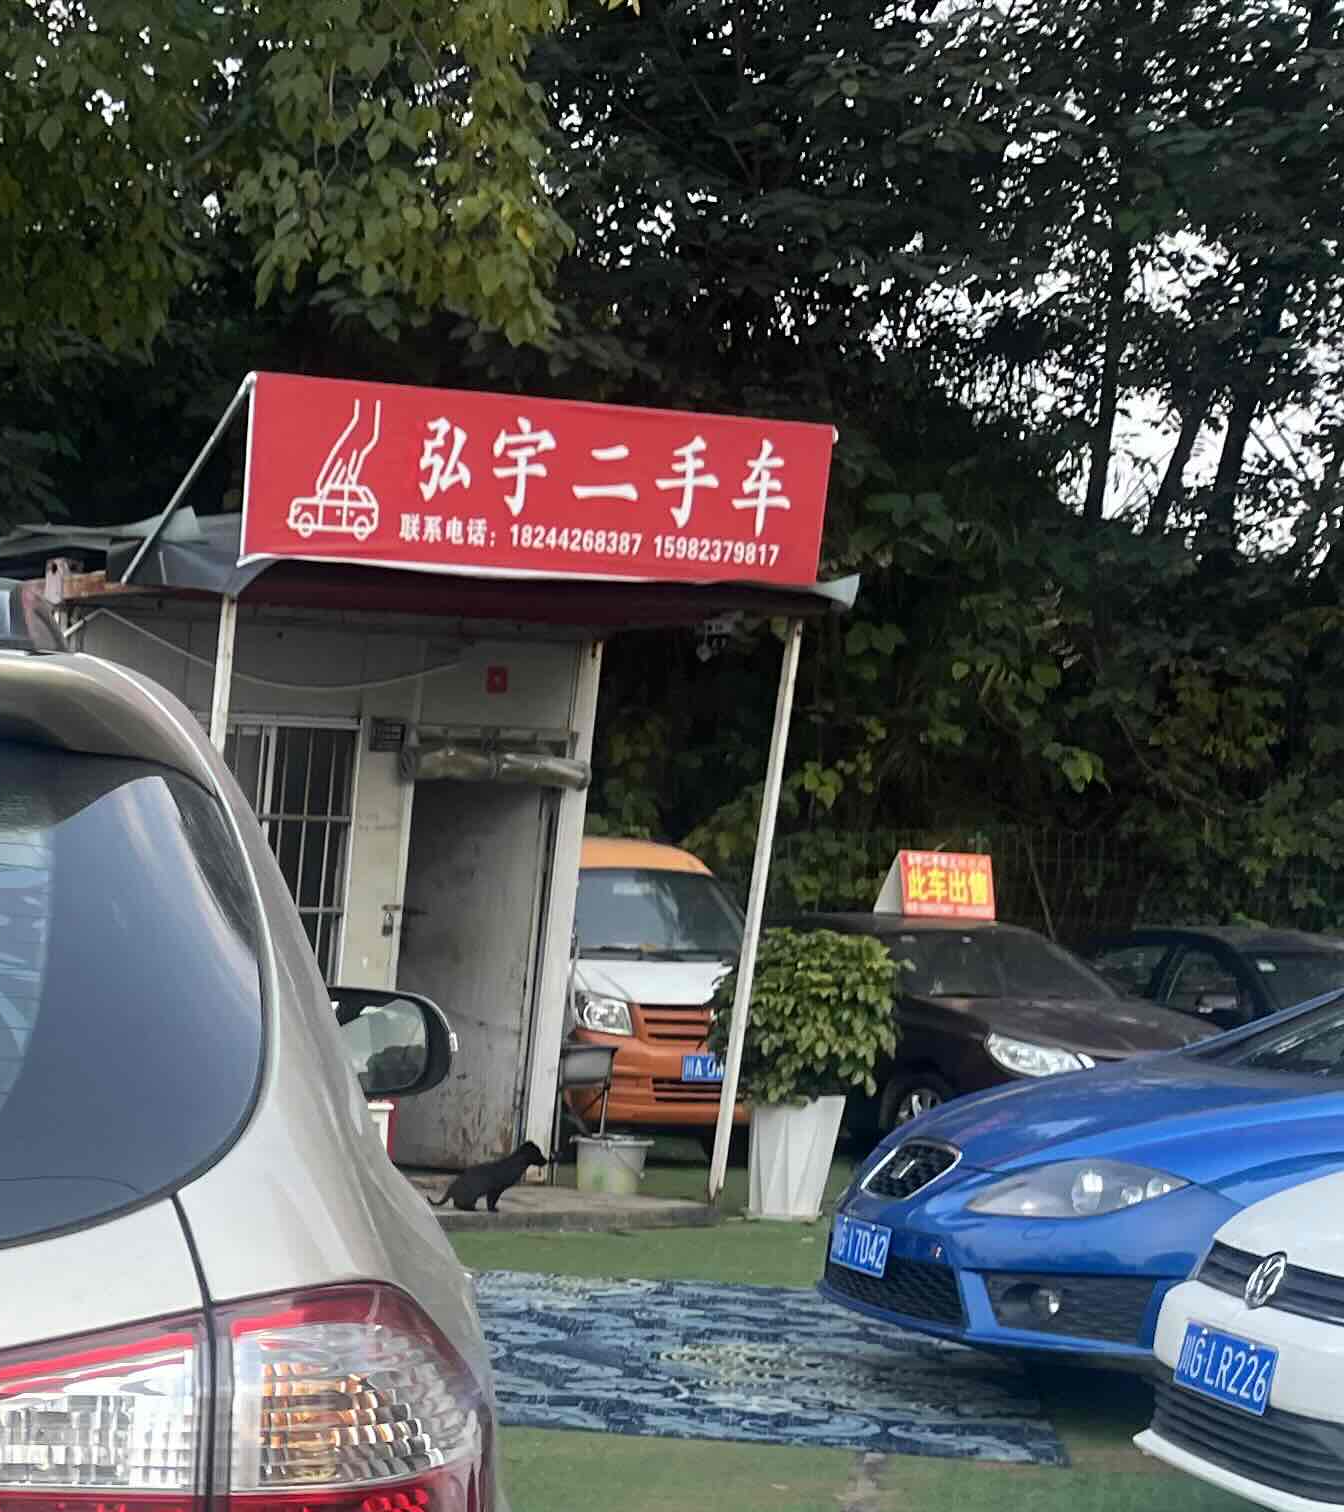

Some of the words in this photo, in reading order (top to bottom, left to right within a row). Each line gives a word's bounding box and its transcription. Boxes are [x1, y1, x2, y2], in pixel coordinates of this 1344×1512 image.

[418, 416, 791, 536] 弘宇二手车
[653, 535, 780, 567] 15982379817
